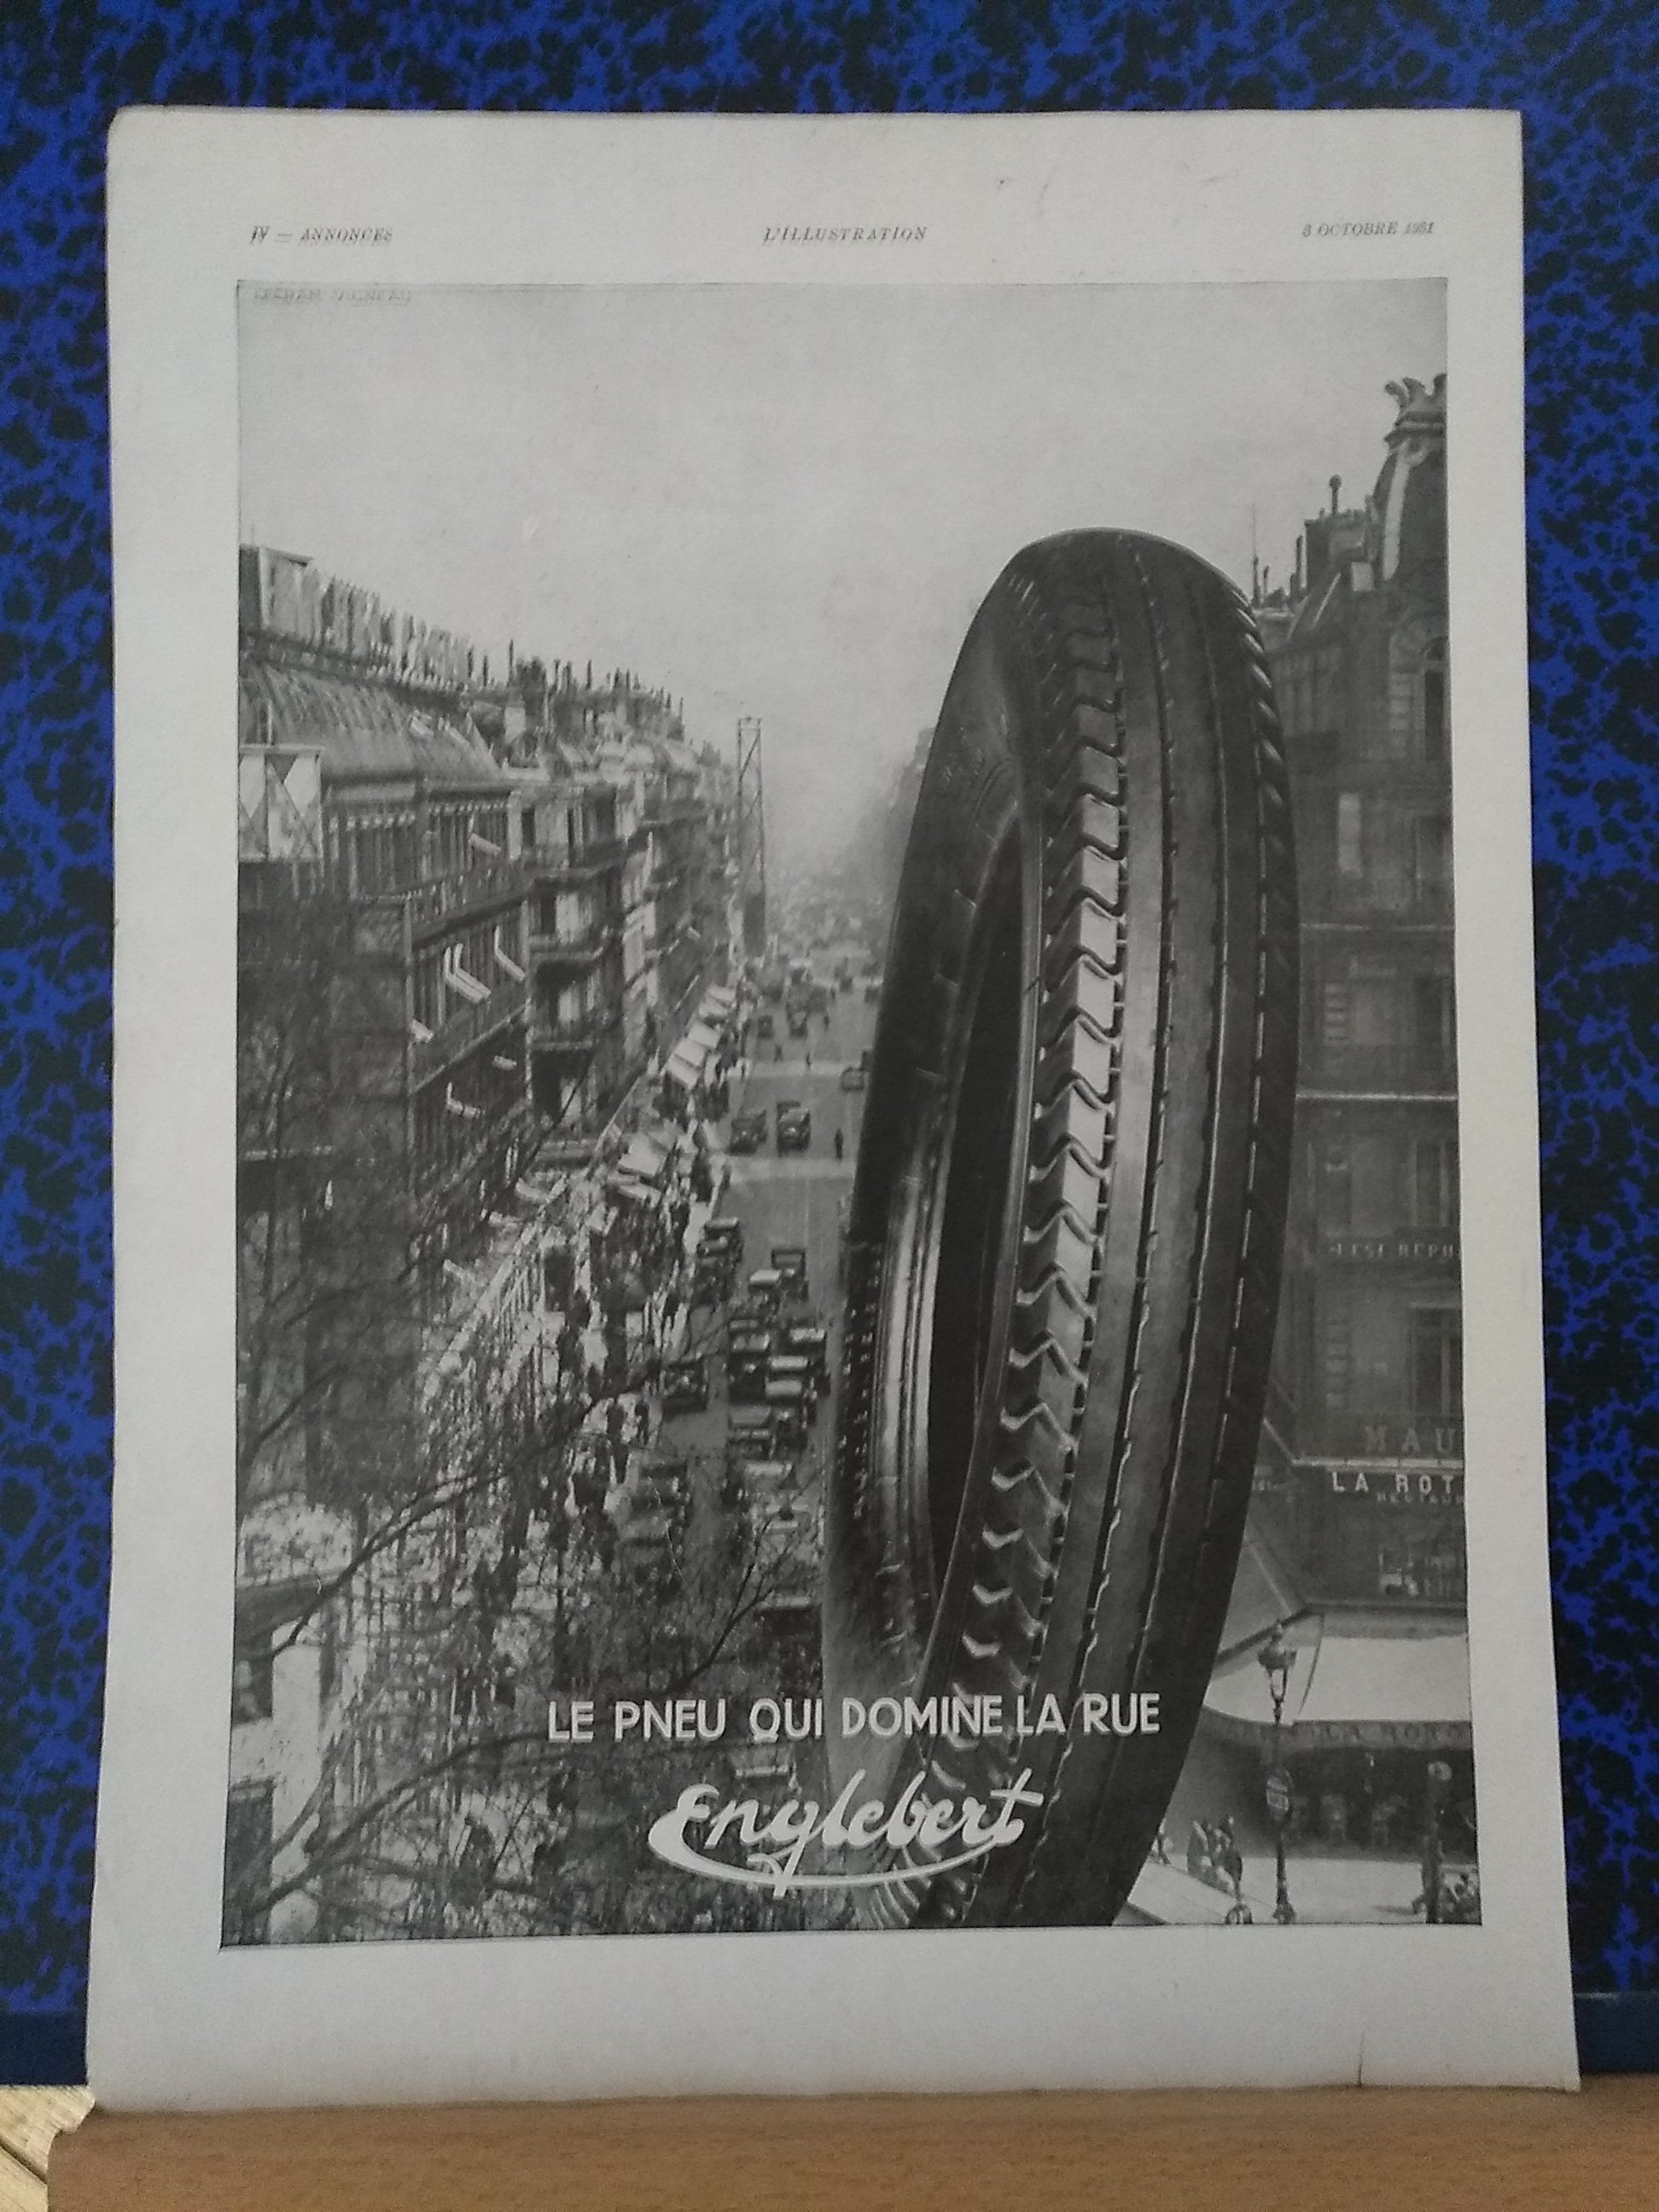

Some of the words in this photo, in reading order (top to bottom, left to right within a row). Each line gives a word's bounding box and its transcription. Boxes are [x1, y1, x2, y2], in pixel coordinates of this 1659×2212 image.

[299, 226, 395, 245] ANNONCES
[764, 225, 928, 243] L'ILLUSTRATION
[1318, 222, 1399, 237] OCTOBRE
[1331, 1471, 1369, 1493] LA
[547, 1700, 596, 1743] LE
[613, 1699, 727, 1743] PNEU
[748, 1698, 824, 1744] QUI
[841, 1694, 1004, 1738] DOMINE
[1016, 1693, 1067, 1737] LA
[1082, 1692, 1161, 1736] RUE
[647, 1767, 1045, 1900] Englebert
